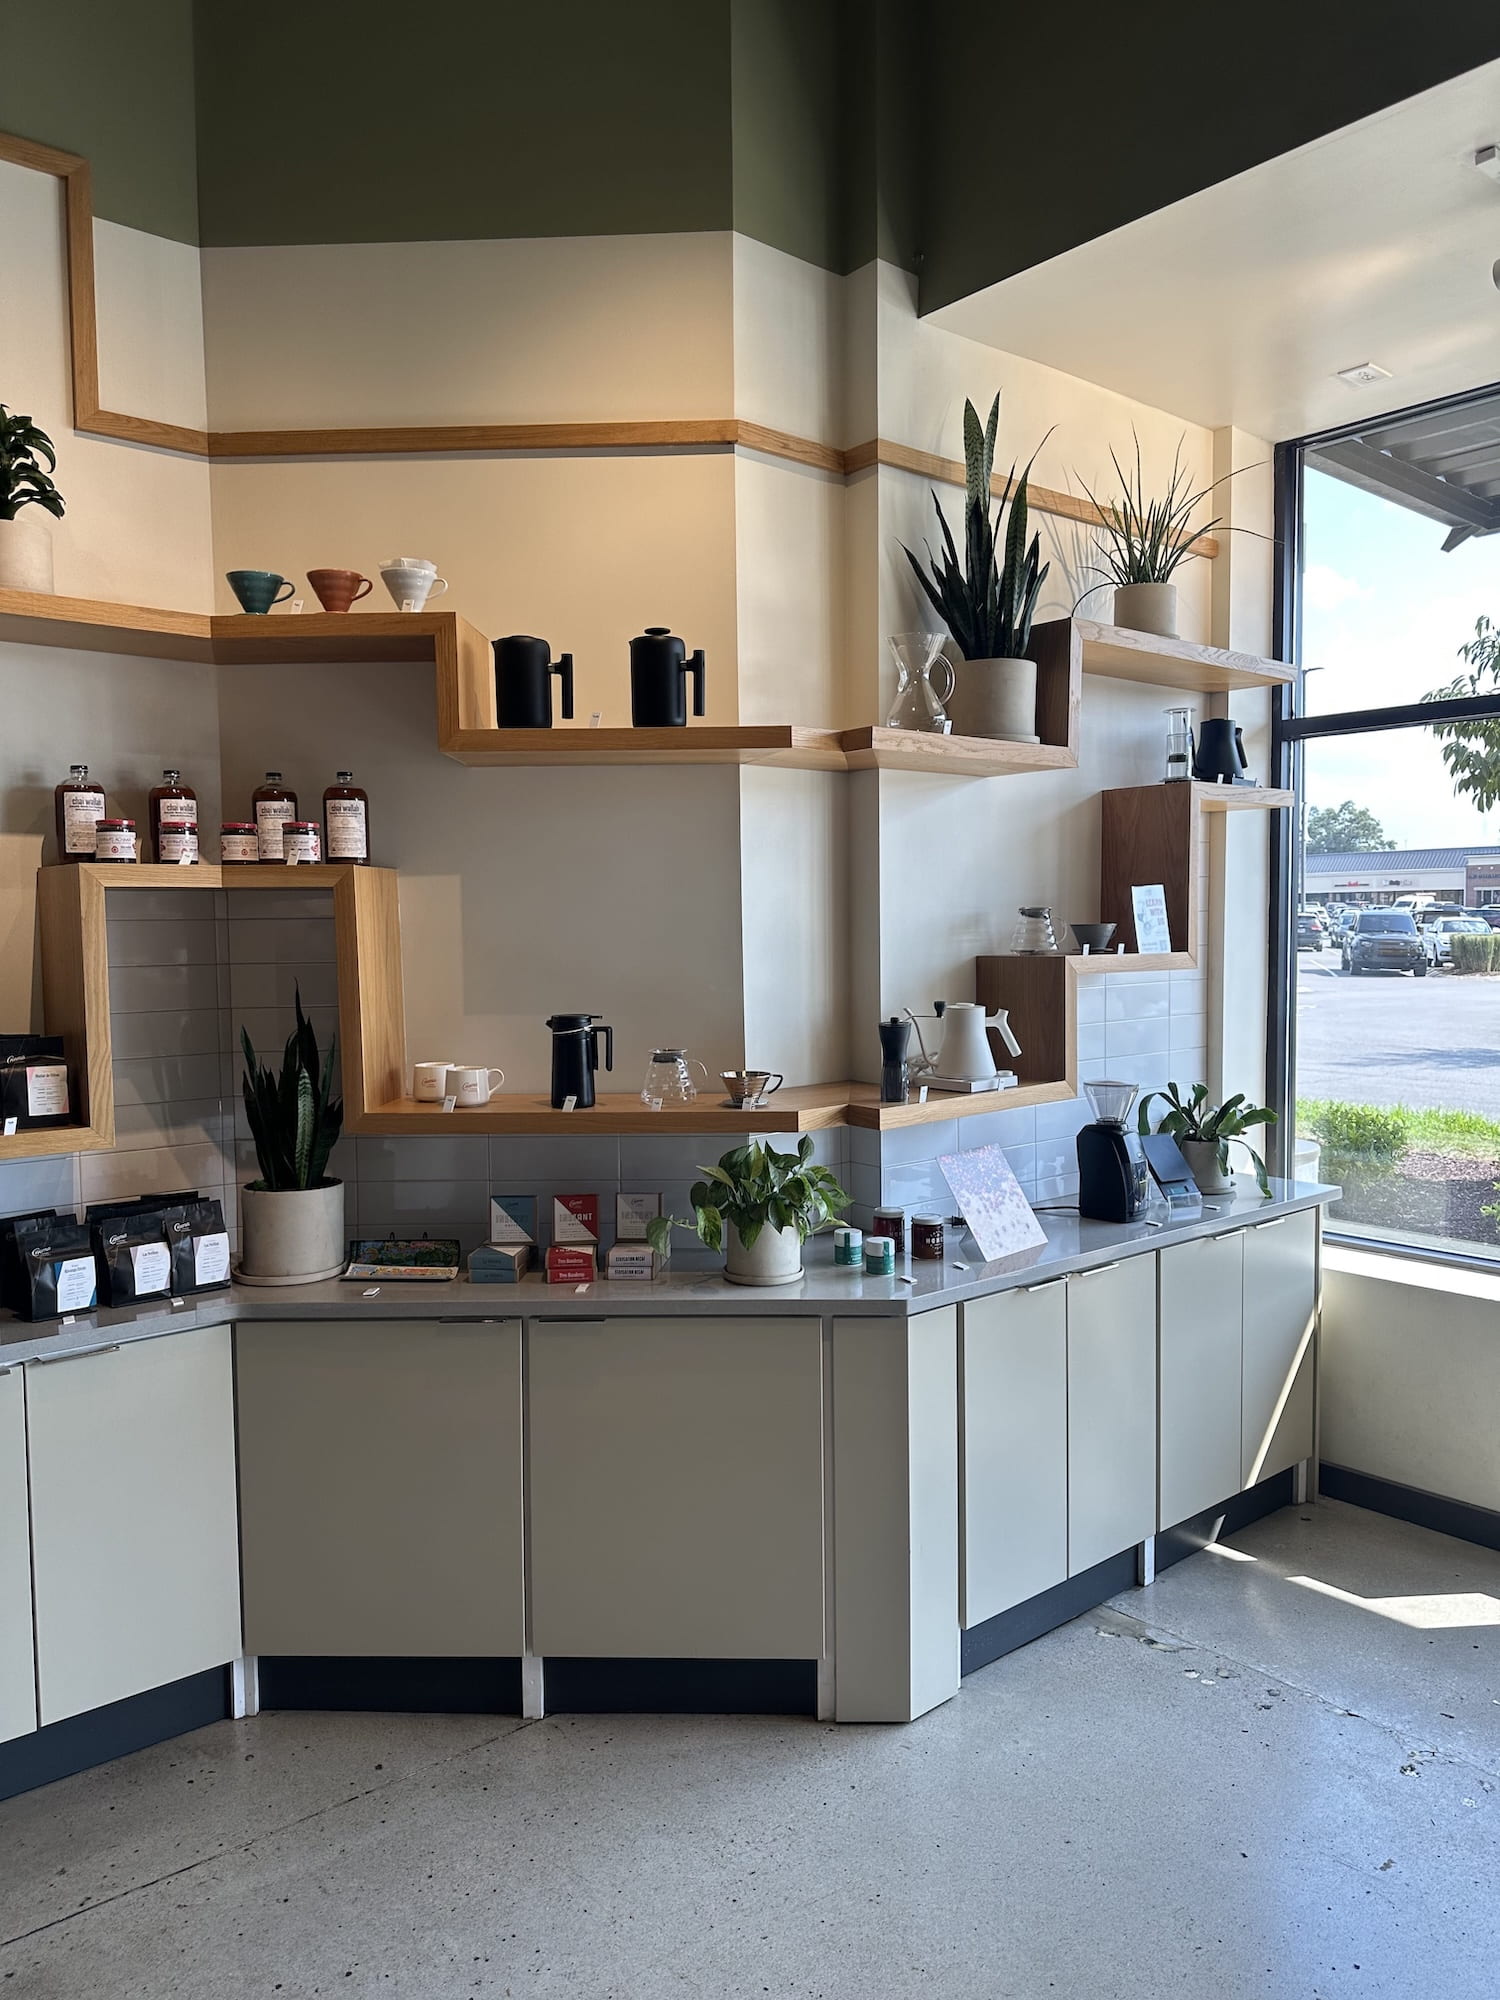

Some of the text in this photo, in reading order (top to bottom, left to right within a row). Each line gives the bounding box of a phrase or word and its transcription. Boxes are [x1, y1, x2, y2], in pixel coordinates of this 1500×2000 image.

[72, 796, 85, 805] chai
[167, 803, 178, 811] chai
[261, 805, 272, 814] chai
[331, 803, 342, 812] chai
